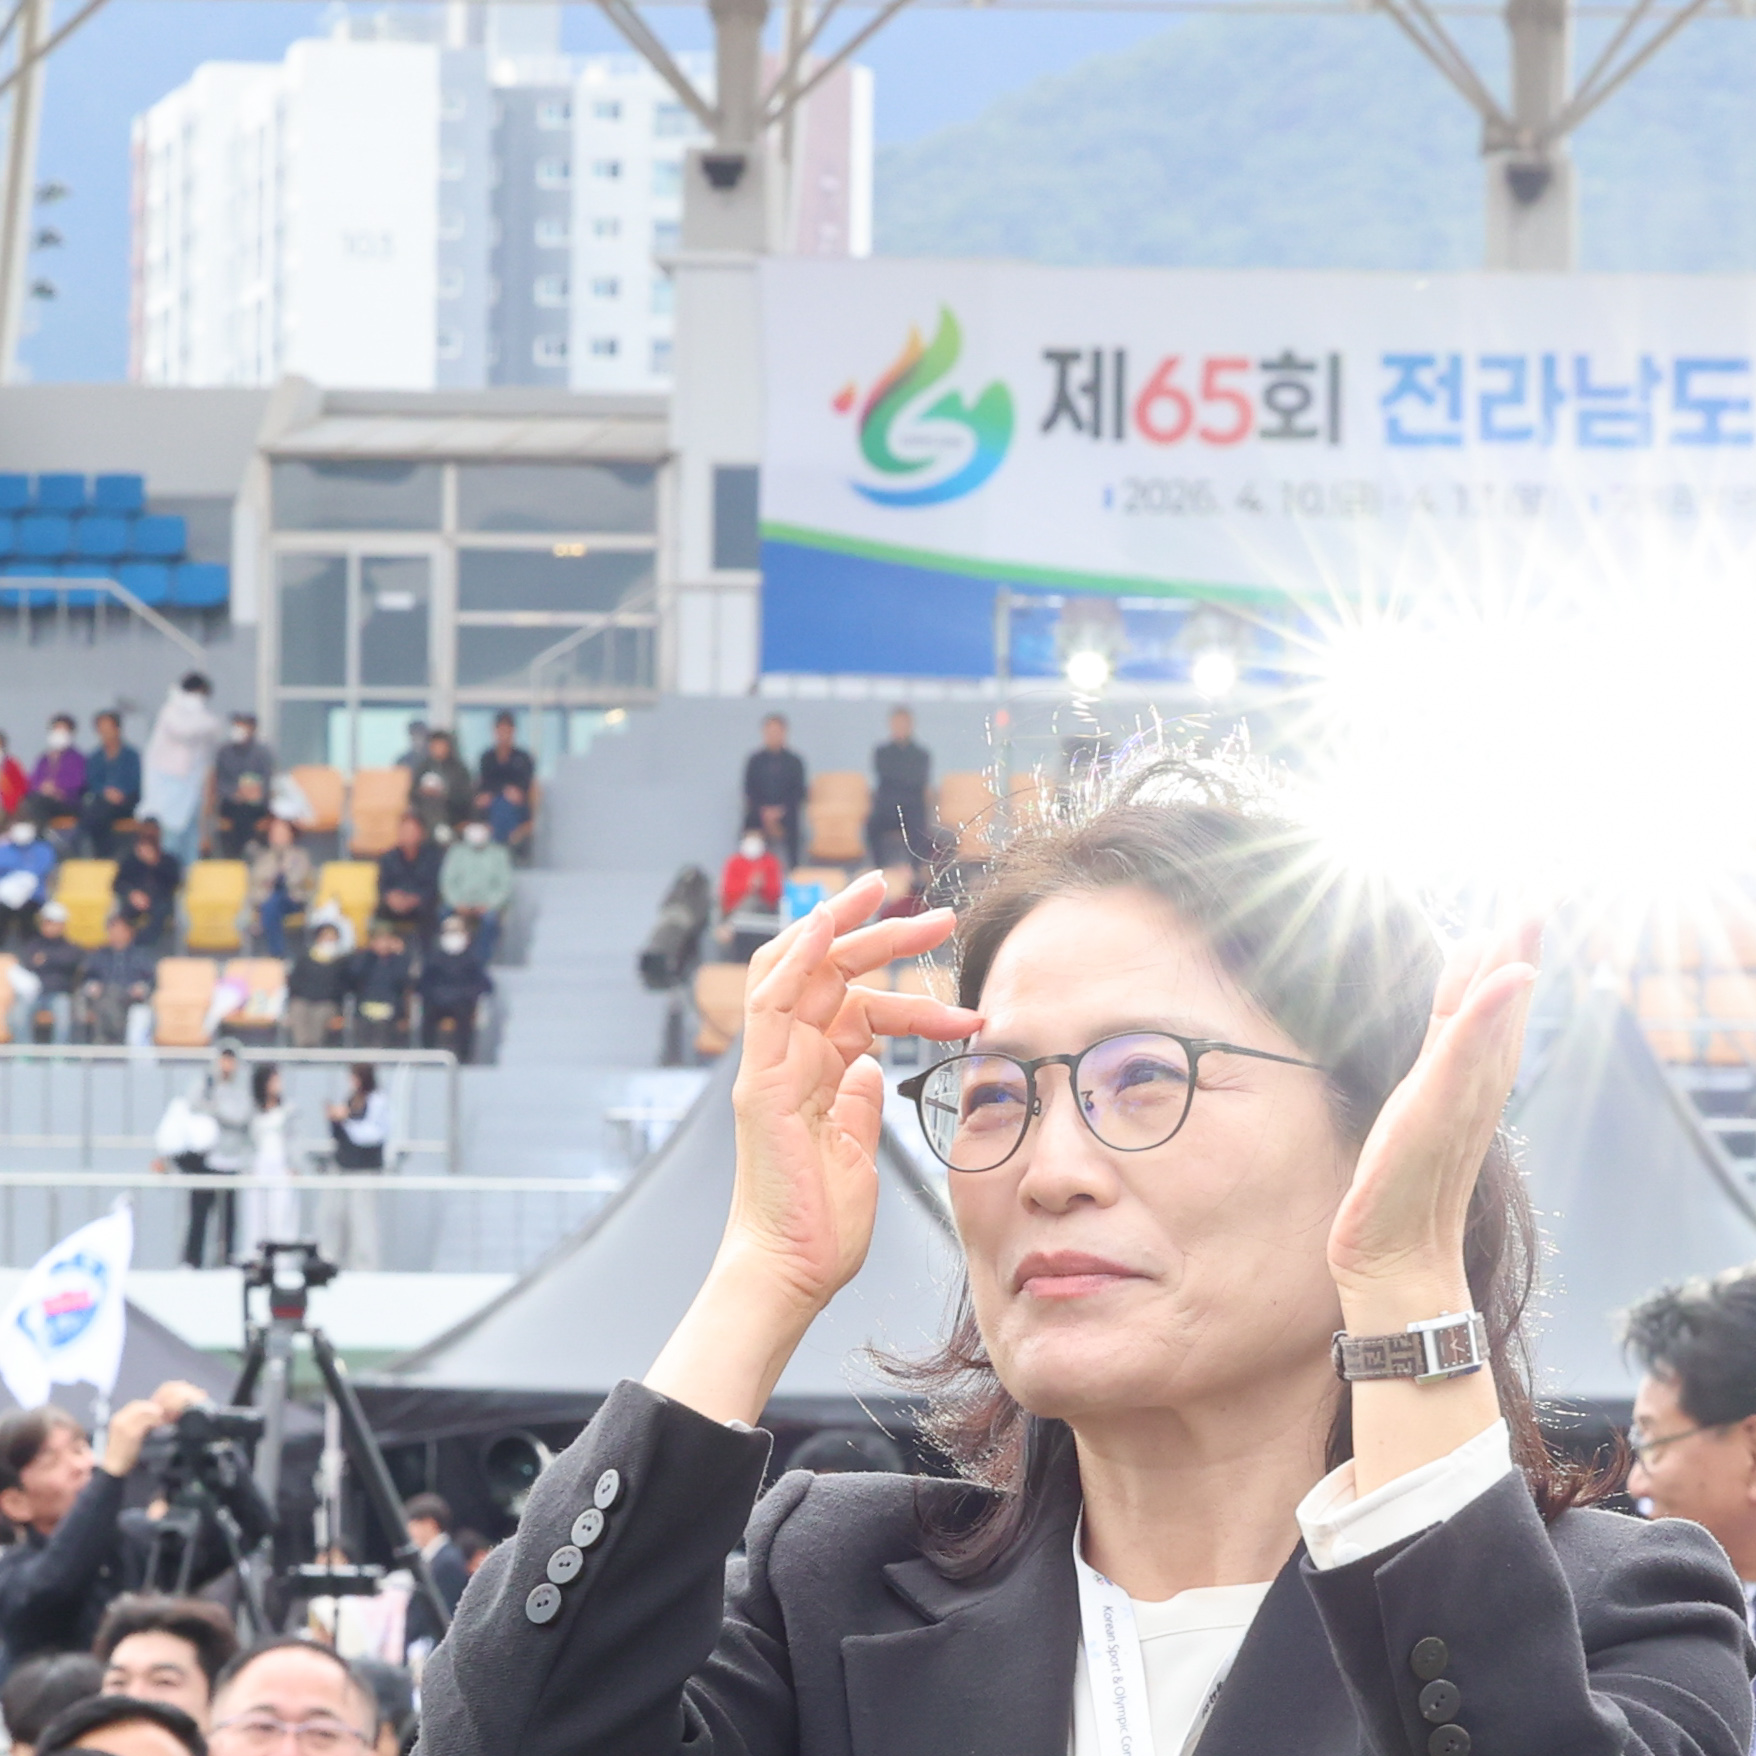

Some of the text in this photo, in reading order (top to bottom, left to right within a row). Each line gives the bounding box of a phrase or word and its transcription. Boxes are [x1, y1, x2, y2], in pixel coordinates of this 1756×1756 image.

[1041, 349, 1341, 446] 제65회
[1103, 1604, 1116, 1642] Korean
[1106, 1643, 1122, 1674] Sport
[1114, 1686, 1129, 1734] Olympic
